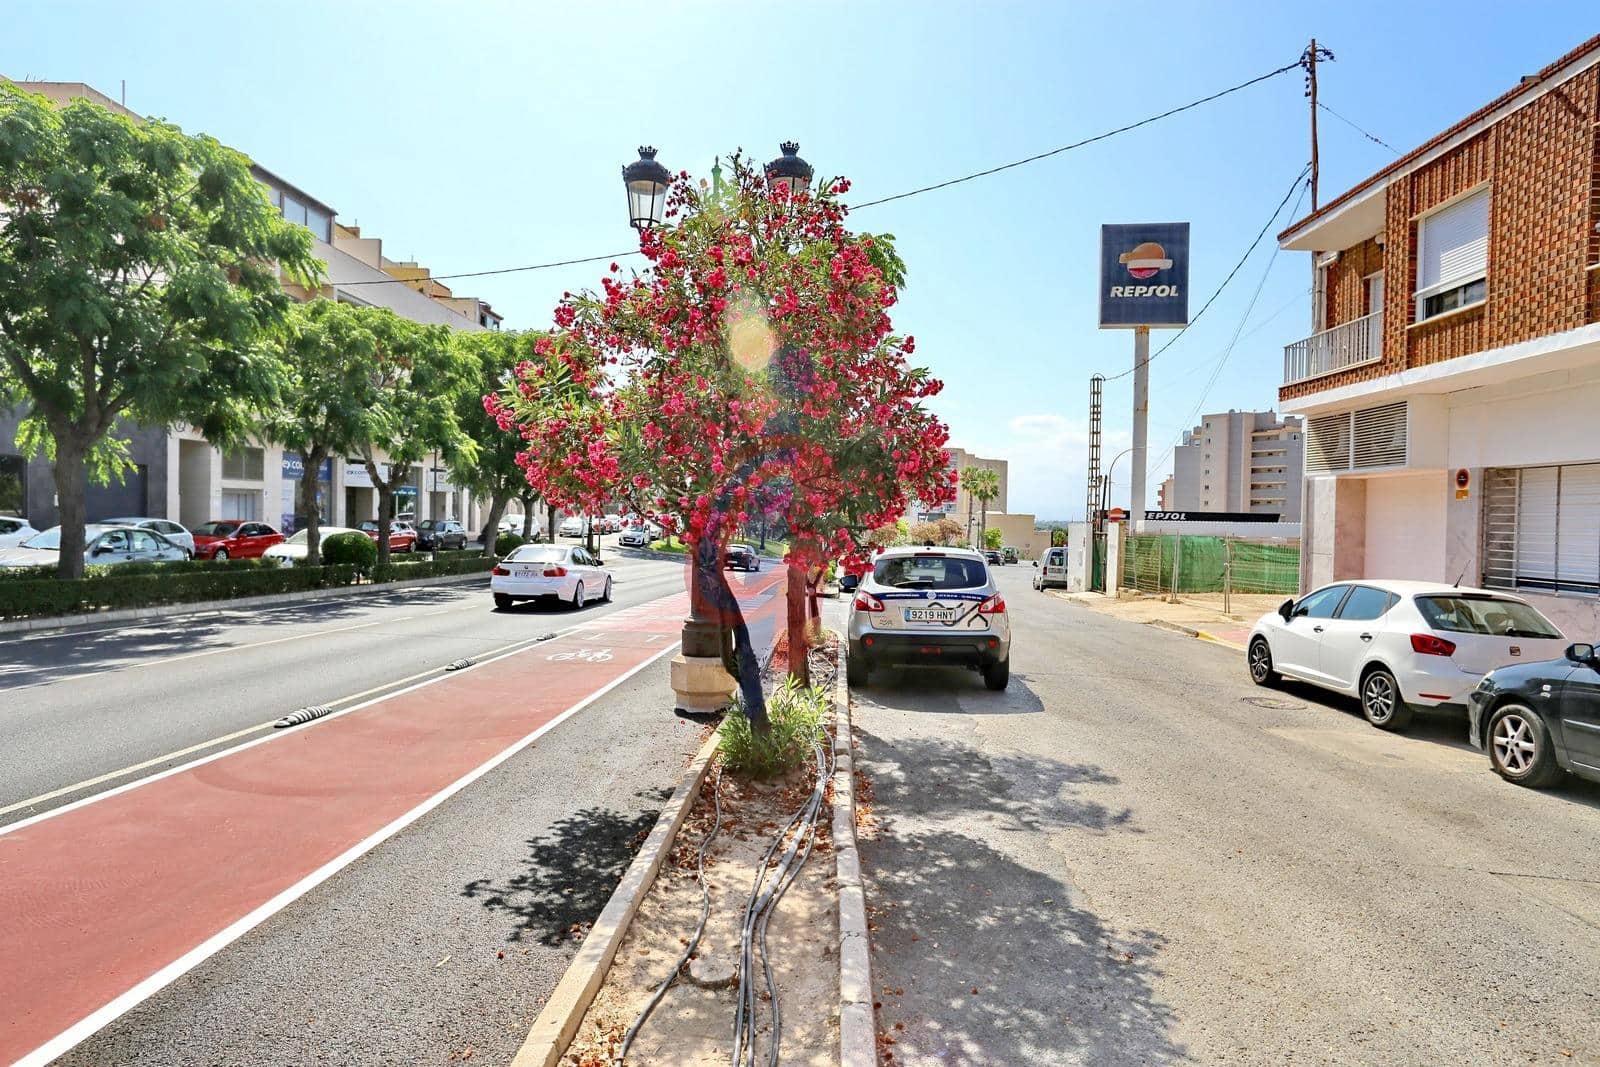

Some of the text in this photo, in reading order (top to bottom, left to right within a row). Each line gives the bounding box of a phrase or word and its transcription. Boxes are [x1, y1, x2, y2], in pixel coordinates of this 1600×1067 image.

[1110, 285, 1179, 298] REPSOL
[911, 610, 954, 620] 9219 HNY
